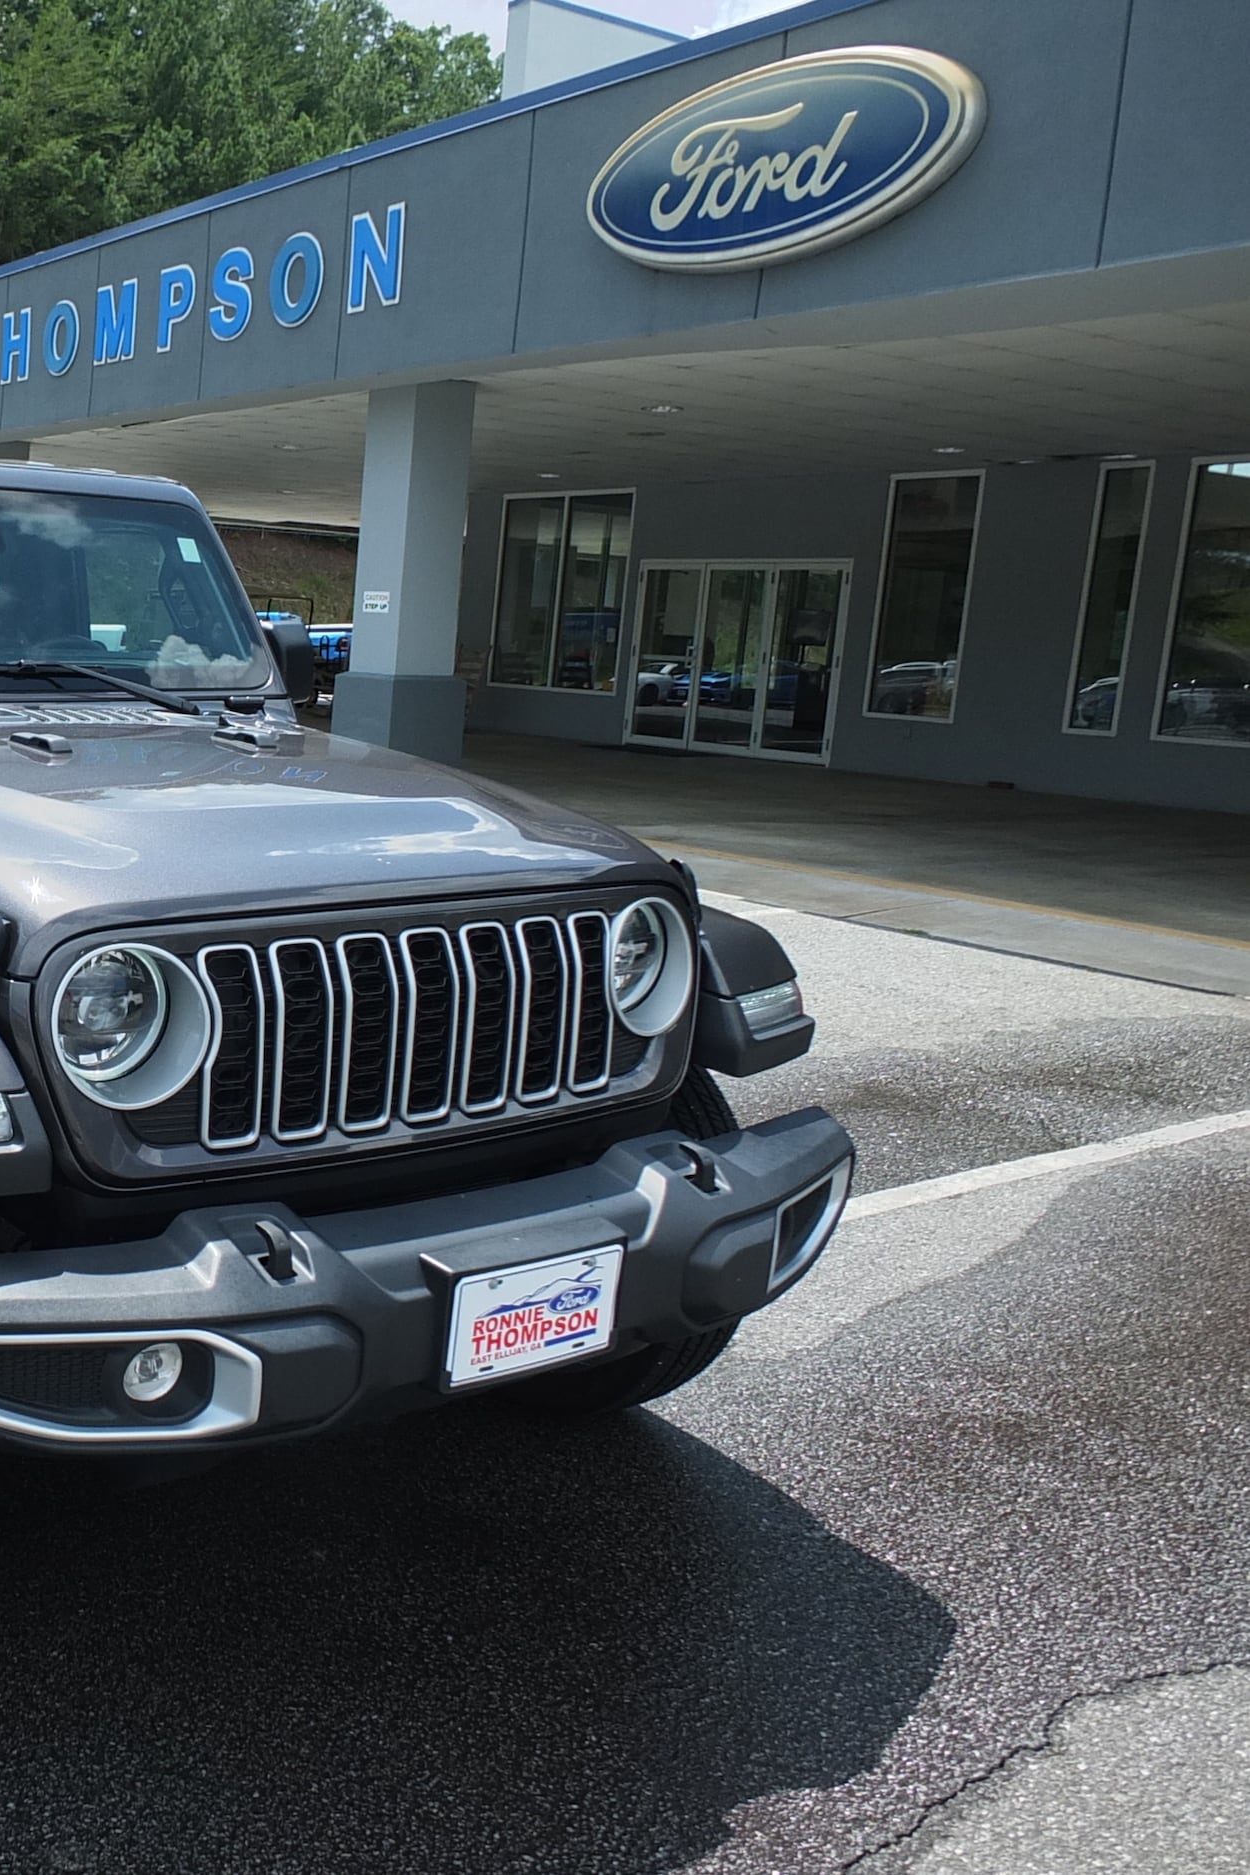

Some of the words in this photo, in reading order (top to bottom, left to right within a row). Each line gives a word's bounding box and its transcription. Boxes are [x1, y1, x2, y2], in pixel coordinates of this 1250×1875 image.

[650, 101, 858, 232] Ford
[557, 1289, 592, 1310] Ford
[472, 1308, 598, 1354] THOMPSON
[473, 1306, 545, 1336] RONNIE
[470, 1355, 491, 1365] EAST
[530, 1342, 542, 1352] GA
